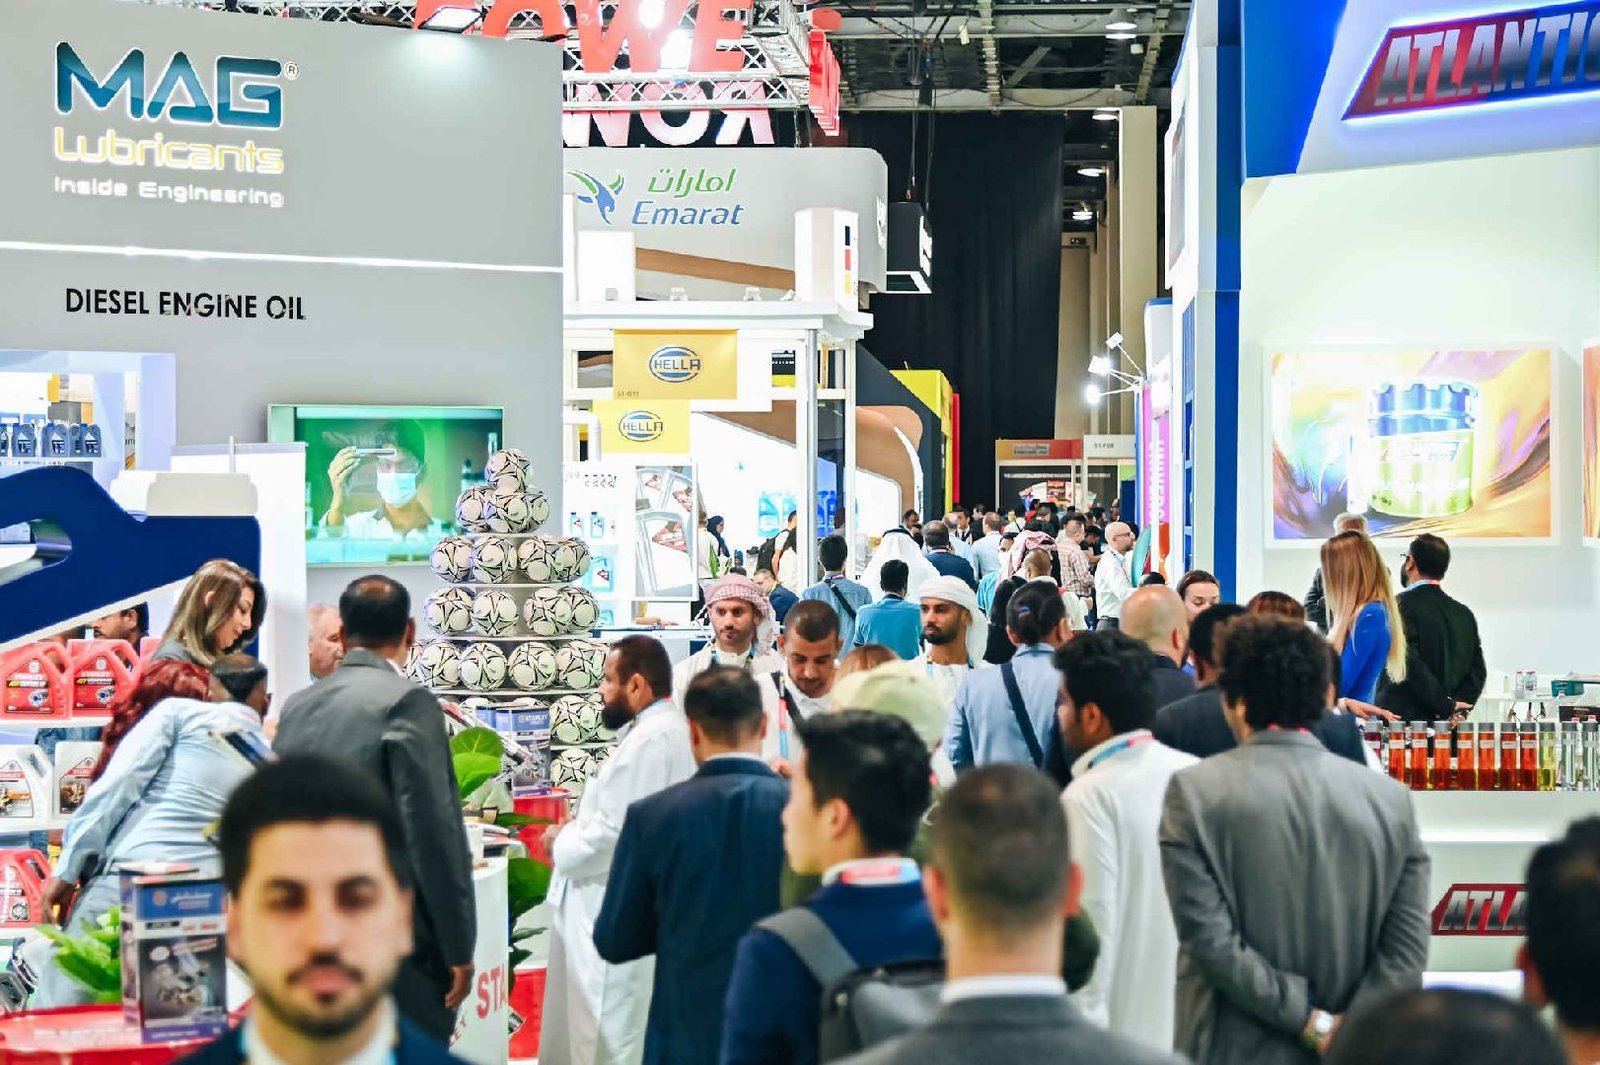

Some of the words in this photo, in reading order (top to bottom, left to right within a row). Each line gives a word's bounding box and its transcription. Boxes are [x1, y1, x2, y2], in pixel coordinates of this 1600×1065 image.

[55, 41, 283, 129] MAG
[54, 127, 284, 175] Lubricants
[54, 177, 128, 196] Inside
[138, 182, 284, 207] Engineering
[631, 200, 745, 225] Emarat
[66, 288, 149, 314] DIESEL
[159, 291, 257, 318] ENGINE
[266, 295, 306, 320] OIL
[654, 358, 702, 371] HELLA
[622, 421, 664, 432] HELLA
